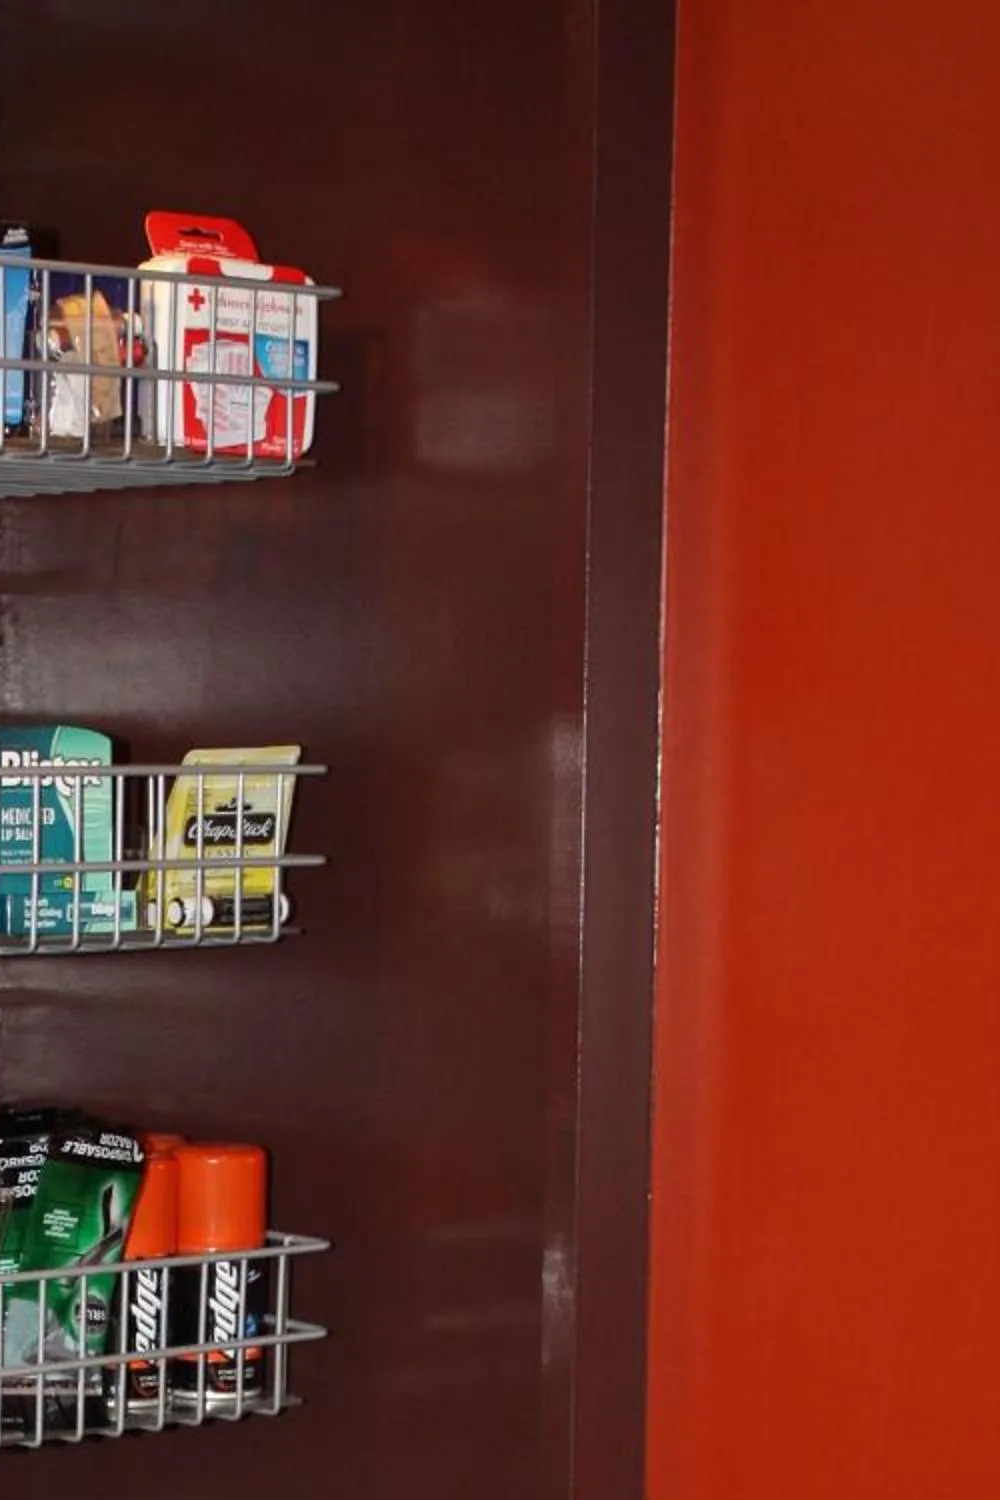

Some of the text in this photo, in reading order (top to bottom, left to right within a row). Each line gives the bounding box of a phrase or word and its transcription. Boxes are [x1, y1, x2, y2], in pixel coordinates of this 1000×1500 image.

[1, 751, 101, 796] Blistex
[131, 1267, 161, 1358] edge
[209, 1261, 240, 1358] edge
